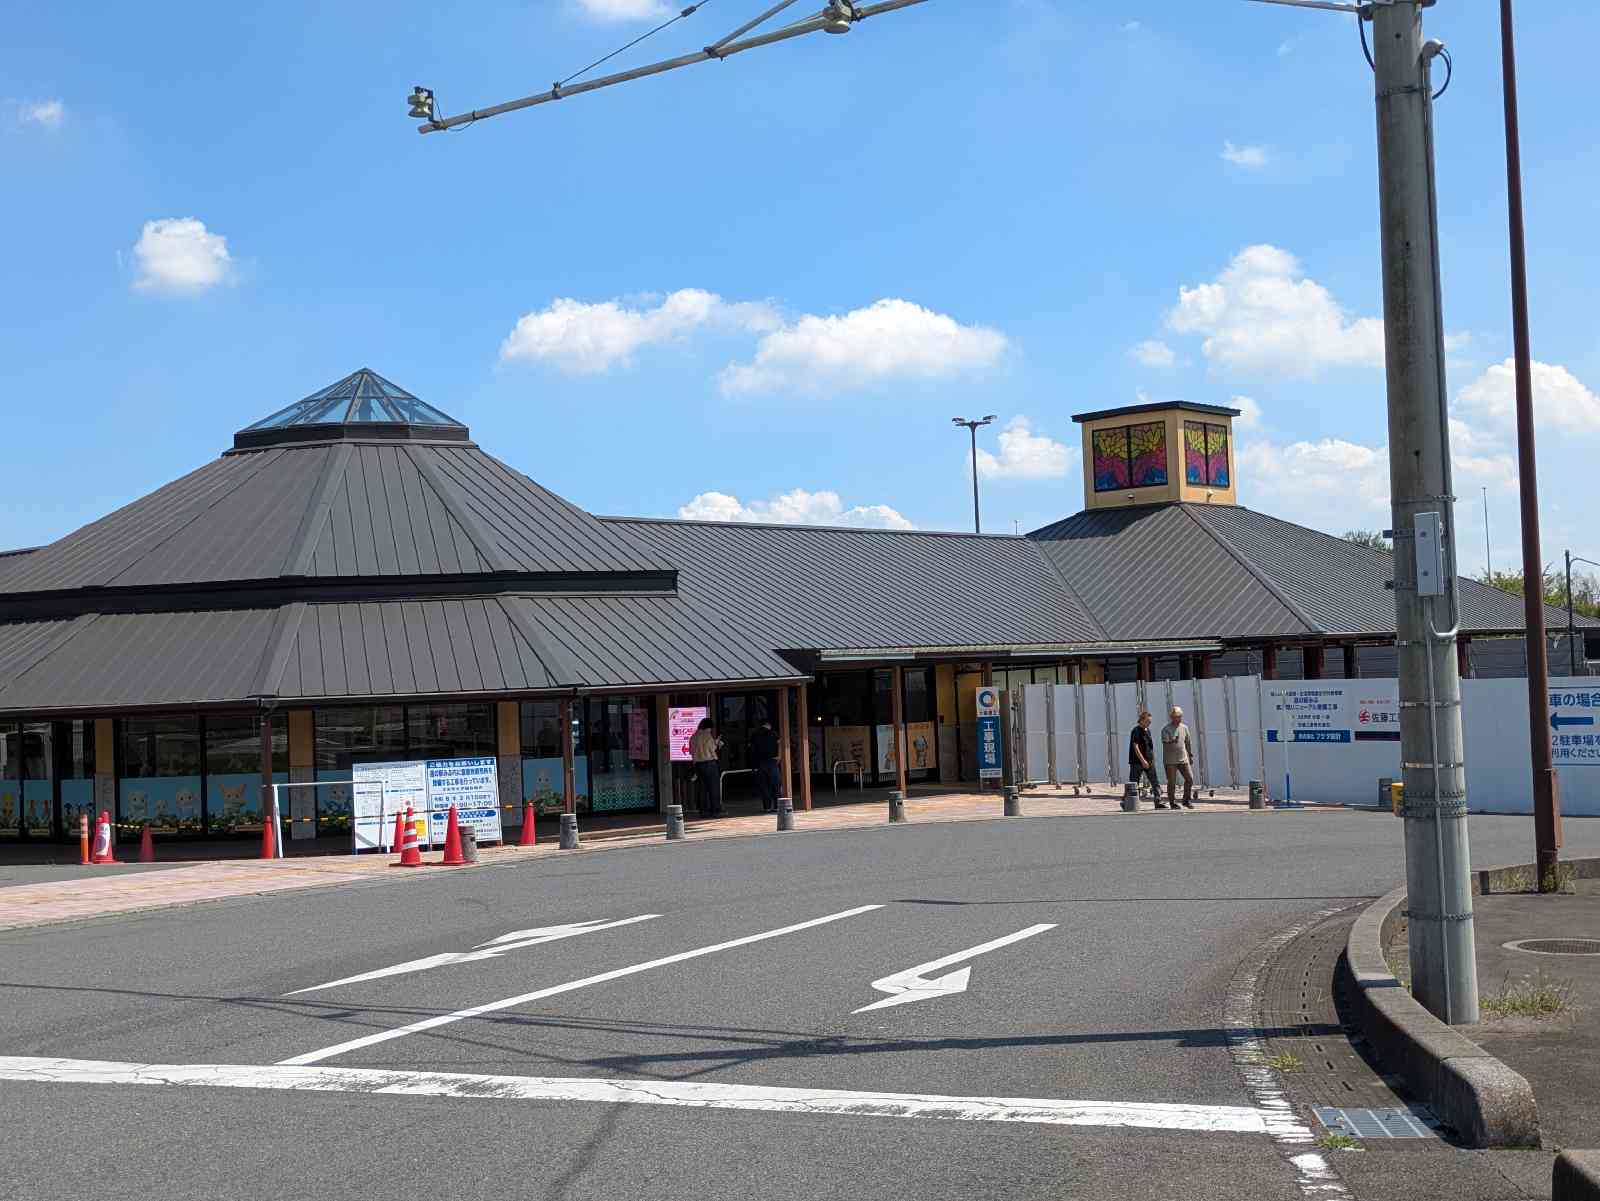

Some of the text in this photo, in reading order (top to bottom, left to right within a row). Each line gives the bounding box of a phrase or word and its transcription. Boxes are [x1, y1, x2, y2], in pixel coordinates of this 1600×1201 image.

[1549, 693, 1600, 707] 車の場合
[1372, 713, 1400, 722] 佐藤工
[983, 720, 996, 765] 工事現場
